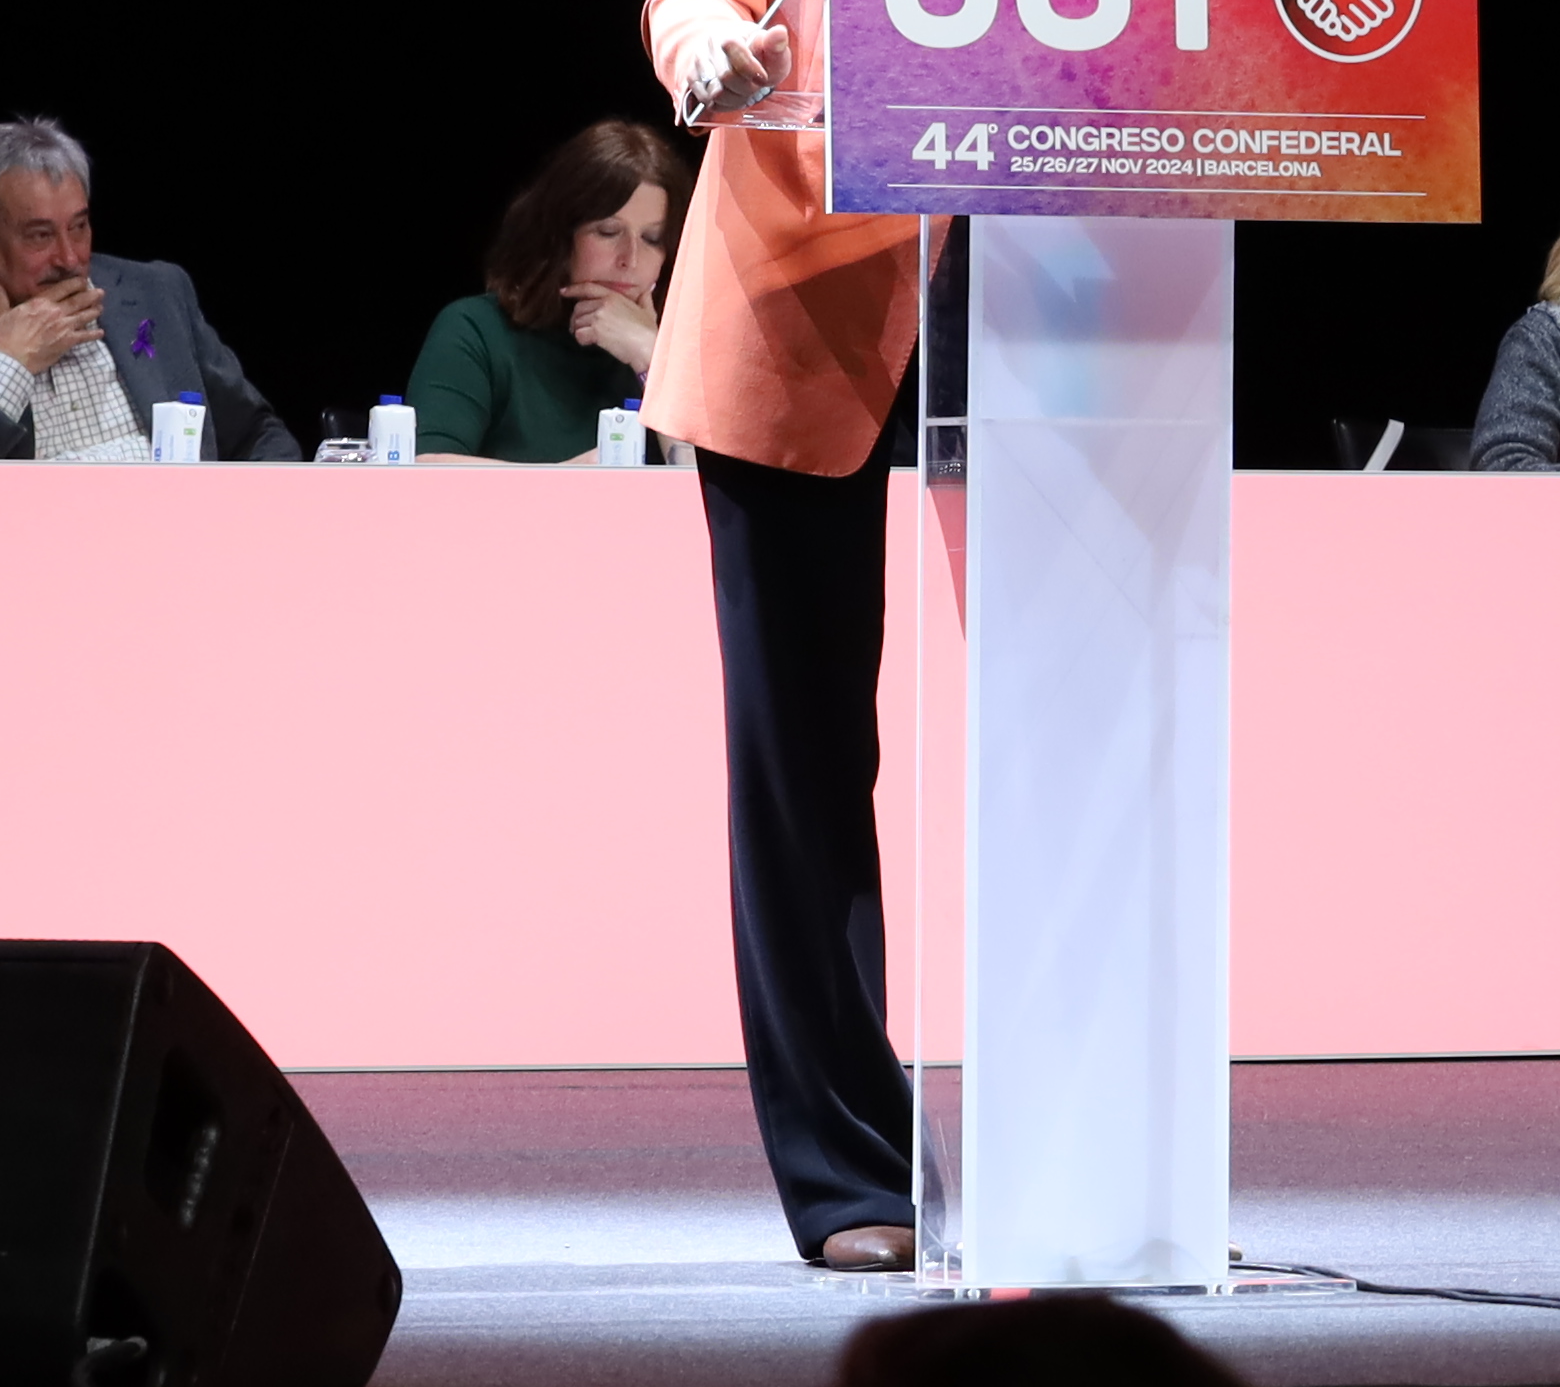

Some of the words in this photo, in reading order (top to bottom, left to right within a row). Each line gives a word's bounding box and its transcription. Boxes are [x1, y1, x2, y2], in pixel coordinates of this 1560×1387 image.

[1007, 124, 1186, 154] CONGRESO
[1192, 127, 1403, 158] CONFEDERAL
[1010, 155, 1101, 175] 25/26/27
[1102, 157, 1143, 175] NOV
[1145, 157, 1195, 176] 2024
[1204, 158, 1322, 178] BARCELONA
